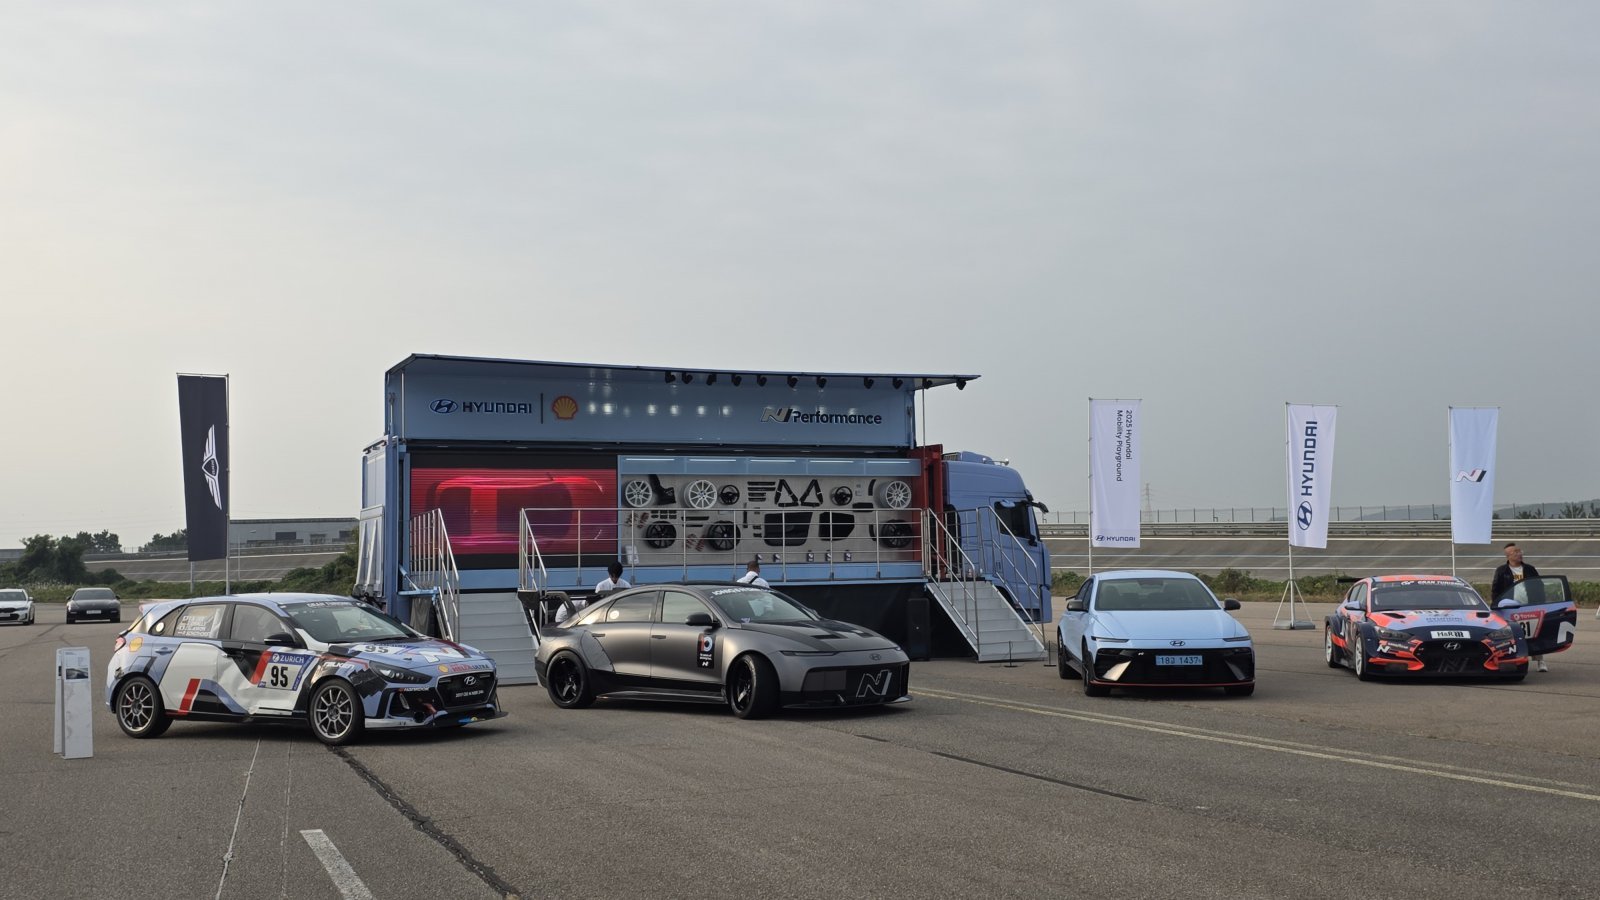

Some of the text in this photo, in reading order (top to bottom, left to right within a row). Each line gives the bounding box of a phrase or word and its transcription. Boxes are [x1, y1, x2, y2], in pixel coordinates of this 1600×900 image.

[462, 401, 532, 414] HYUNDAI
[792, 411, 882, 424] Performance
[1124, 429, 1132, 460] Hyundai
[1301, 421, 1318, 496] HYUNDAI
[364, 645, 389, 653] 95
[270, 665, 288, 687] 95
